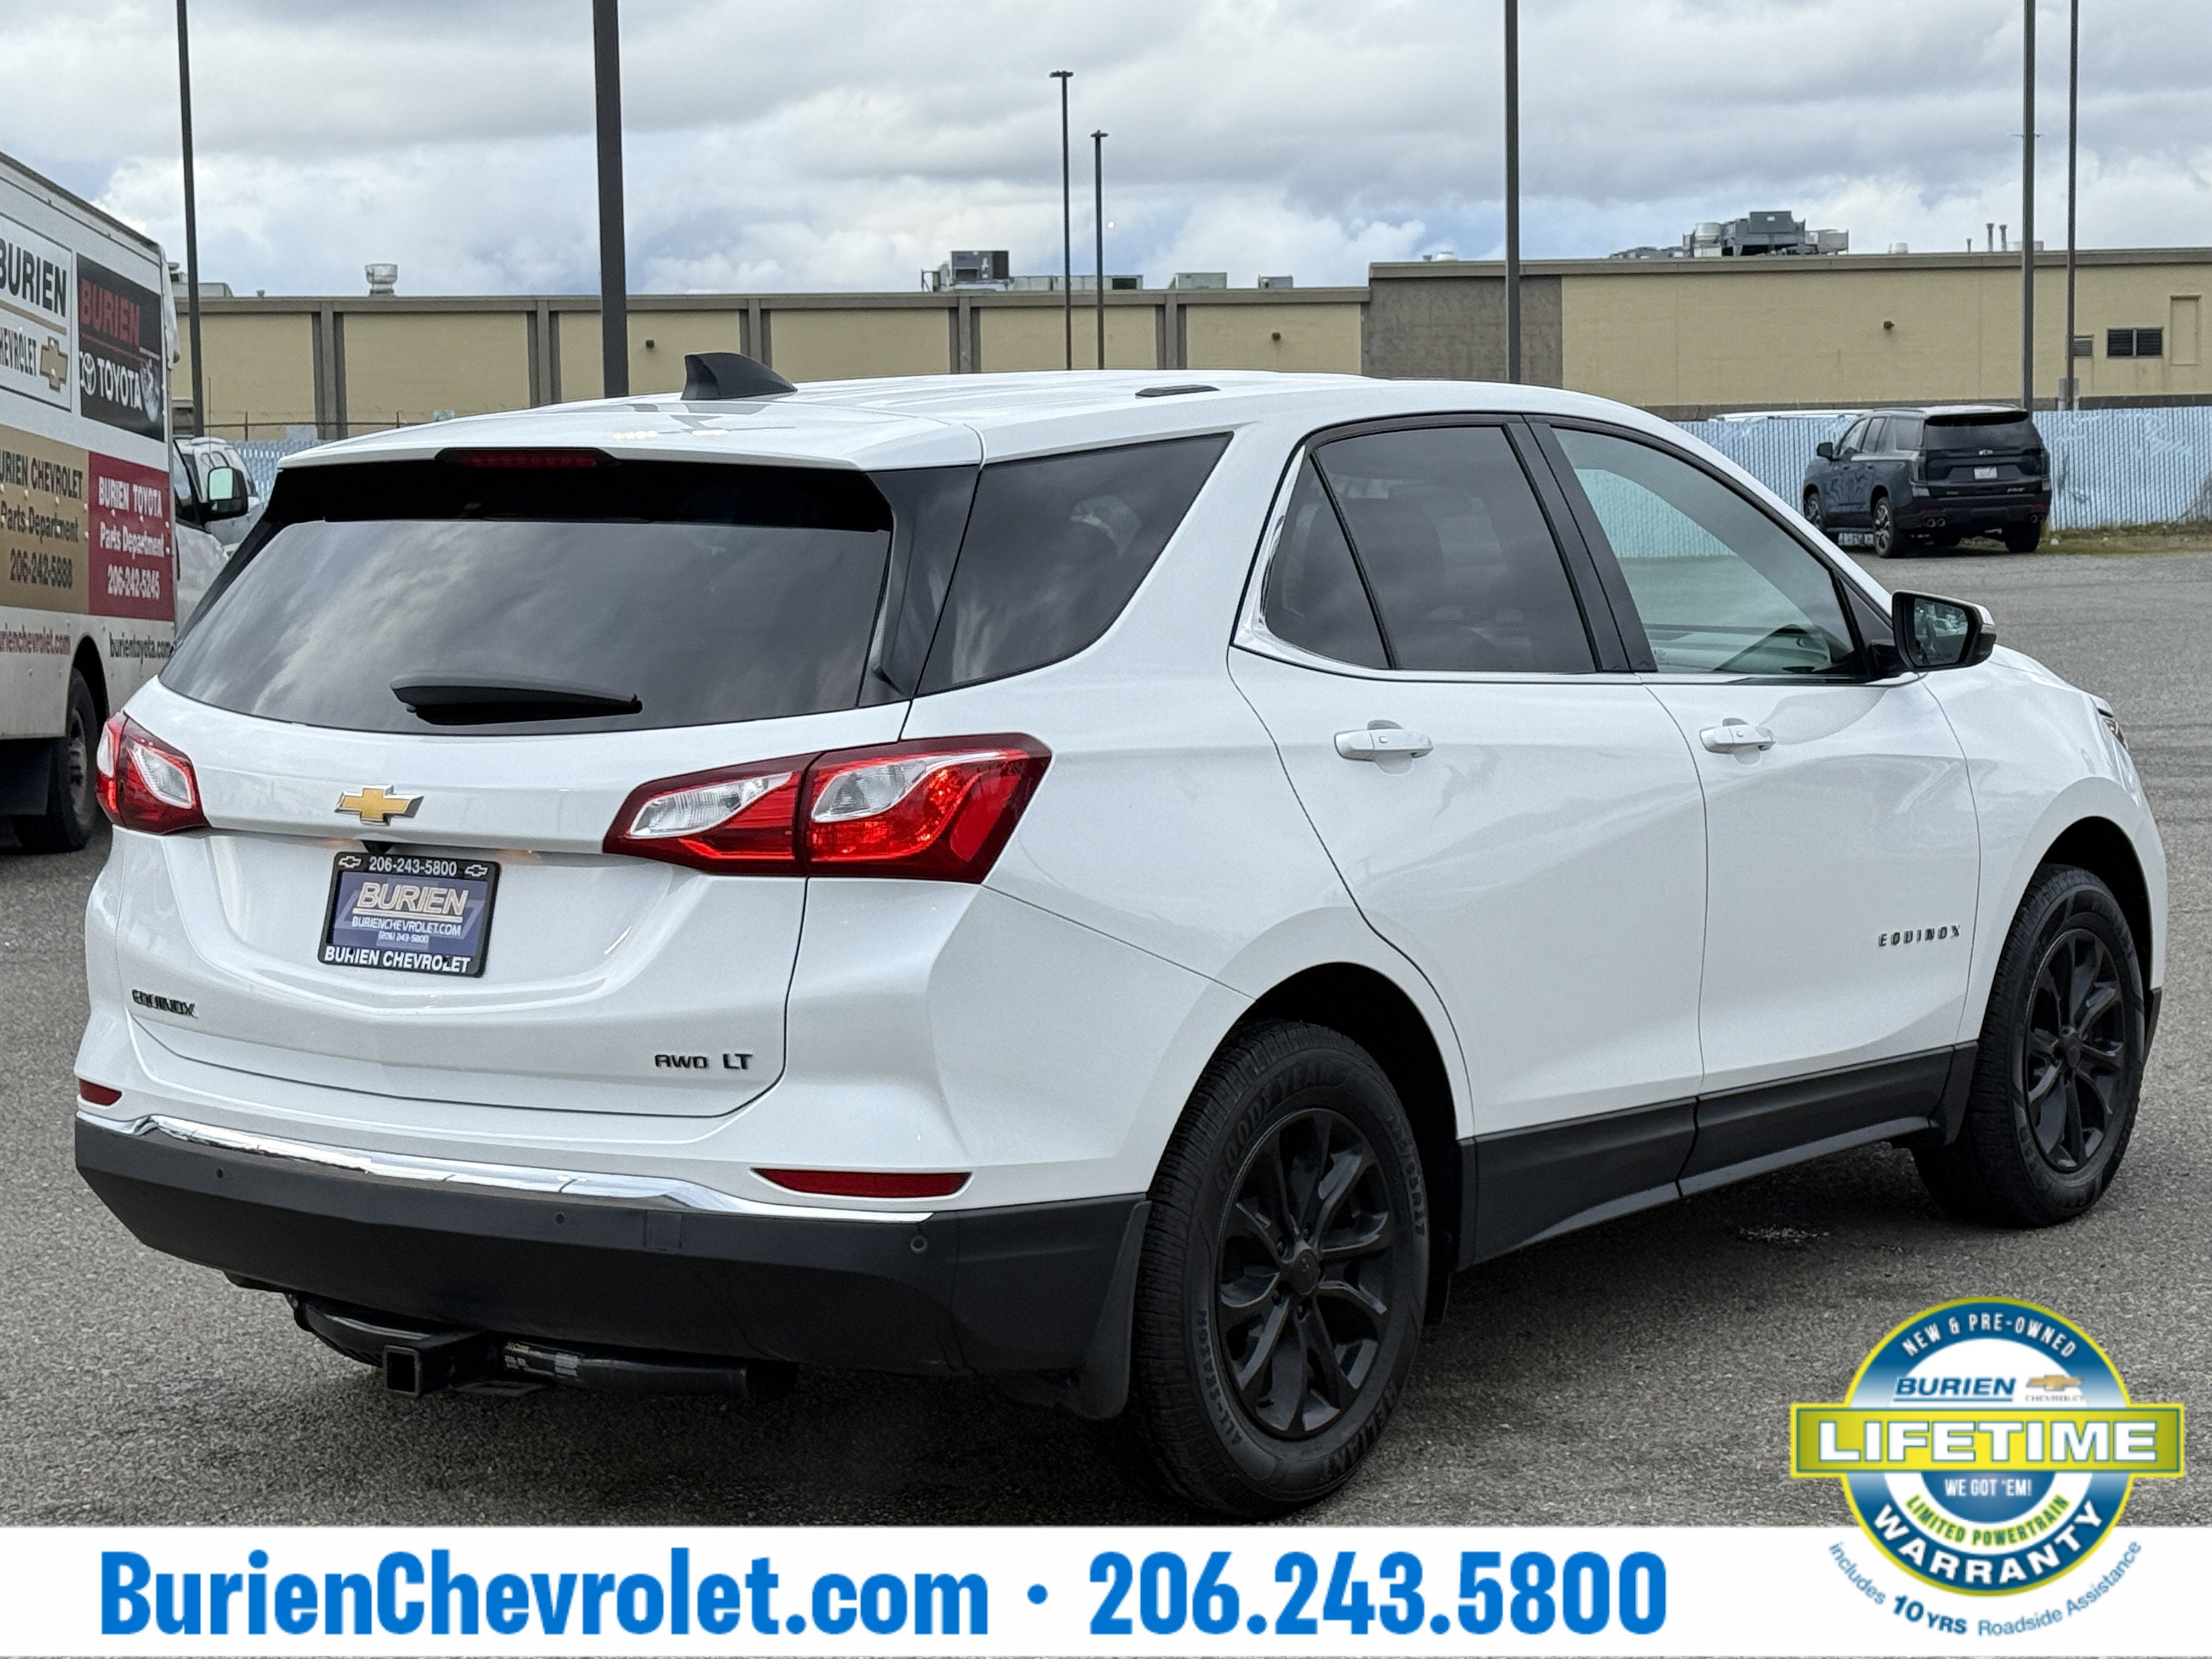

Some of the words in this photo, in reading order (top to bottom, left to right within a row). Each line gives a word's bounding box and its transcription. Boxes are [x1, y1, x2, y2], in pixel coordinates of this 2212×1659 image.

[82, 278, 140, 346] BURIEN
[0, 327, 37, 377] HEVROLET
[97, 357, 143, 411] TOYOTA
[0, 449, 28, 487] URIEN
[31, 456, 83, 500] CHEVROLET
[98, 476, 129, 511] BURIEN
[133, 484, 163, 518] TOYOTA
[1, 500, 26, 533] Parts
[28, 506, 78, 543] Department
[100, 521, 121, 551] Parts
[122, 526, 165, 560] Department
[369, 856, 457, 876] 206-243-5800
[357, 882, 469, 916] BURIEN
[352, 916, 461, 936] BURIENCHEVROLET.COM
[1878, 924, 1961, 947] EQUINOX
[324, 946, 380, 966] BURIEN
[383, 951, 471, 973] CHEVROLET
[654, 1054, 708, 1069] AWD
[723, 1053, 753, 1070] LT
[1216, 1061, 1333, 1192] GOODYEAR
